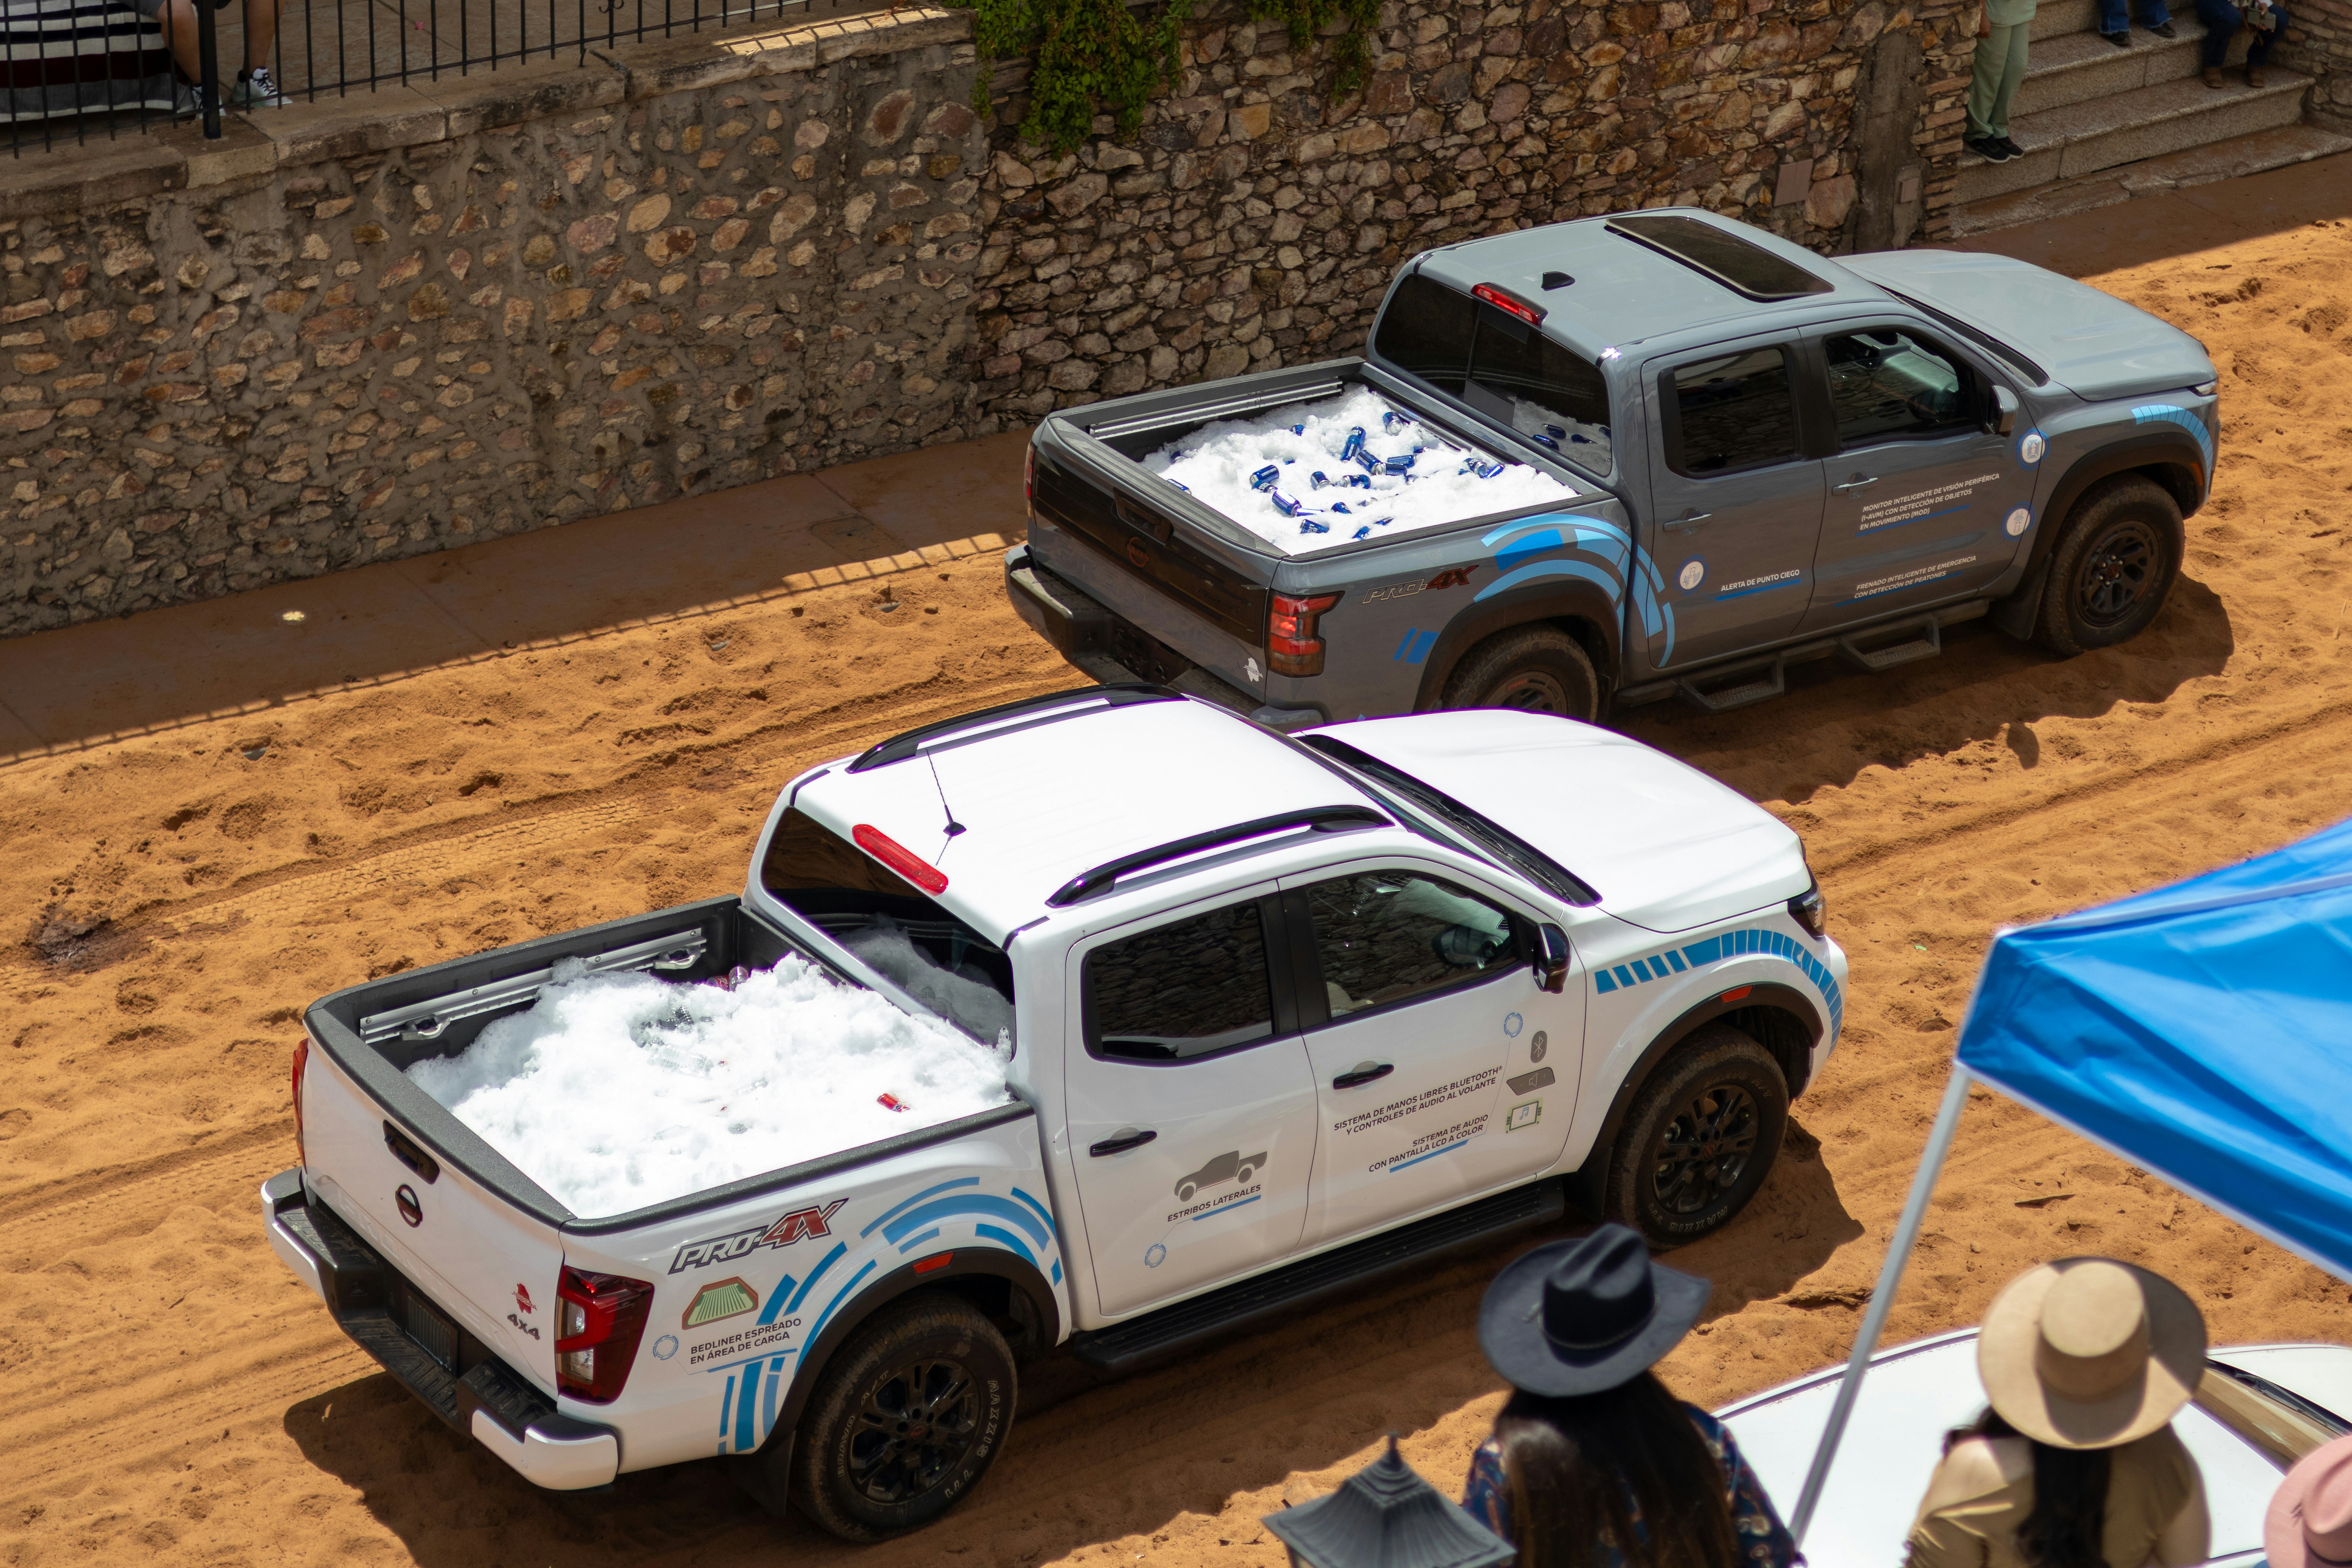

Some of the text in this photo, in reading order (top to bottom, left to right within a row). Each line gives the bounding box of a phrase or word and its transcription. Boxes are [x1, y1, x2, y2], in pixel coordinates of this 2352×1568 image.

[1279, 500, 1288, 508] LIGHT
[1862, 511, 1884, 523] (I-AVM)
[1885, 507, 1898, 515] CON
[1900, 498, 1934, 512] DETECCIÓN
[1945, 489, 1972, 501] OBJETOS
[1863, 500, 1893, 512] MONITOR
[1893, 490, 1933, 505] INTELIGENTE
[1943, 482, 1964, 492] VISIÓN
[1964, 473, 2000, 487] PERIFÉRICA
[1870, 513, 1910, 529] MOVIMIENTO
[1911, 508, 1930, 519] (MOD)
[1361, 564, 1479, 604] PRO-4X
[1721, 581, 1746, 592] ALERTA
[1757, 574, 1779, 584] PUNTO
[1780, 569, 1800, 579] CIEGO
[1857, 579, 1886, 590] FRENADO
[1887, 568, 1927, 583] INTELIGENTE
[1937, 555, 1976, 570] EMERGENCIA
[1869, 581, 1904, 595] DETECCIÓN
[1914, 571, 1947, 584] PEATONES
[1703, 1072, 1749, 1089] BRAVO
[1334, 1112, 1371, 1131] SISTEMA
[1373, 1107, 1385, 1117] DE
[1386, 1096, 1417, 1113] MANOS
[1419, 1085, 1448, 1101] LIBRES
[1353, 1112, 1404, 1133] CONTROLES
[1406, 1105, 1417, 1115] DE
[1418, 1095, 1445, 1110] AUDIO
[1446, 1092, 1457, 1101] AL
[1458, 1077, 1496, 1096] VOLANTE
[1368, 1160, 1387, 1172] CON
[1389, 1144, 1430, 1165] PANTALLA
[1432, 1138, 1447, 1149] LCD
[1456, 1124, 1483, 1140] COLOR
[1412, 1114, 1488, 1147] SISTEMA DE AUDIO
[1167, 1184, 1261, 1222] ESTRIBOS LATERALES
[1668, 1205, 1728, 1233] MAXXIS
[667, 1197, 849, 1275] PRO-4X
[690, 1332, 790, 1365] EN ÁREA DE CARGA
[691, 1318, 801, 1354] BEDLINER ESPREADO
[977, 1380, 1000, 1458] MAXXIS
[837, 1416, 856, 1477] BRAVO
